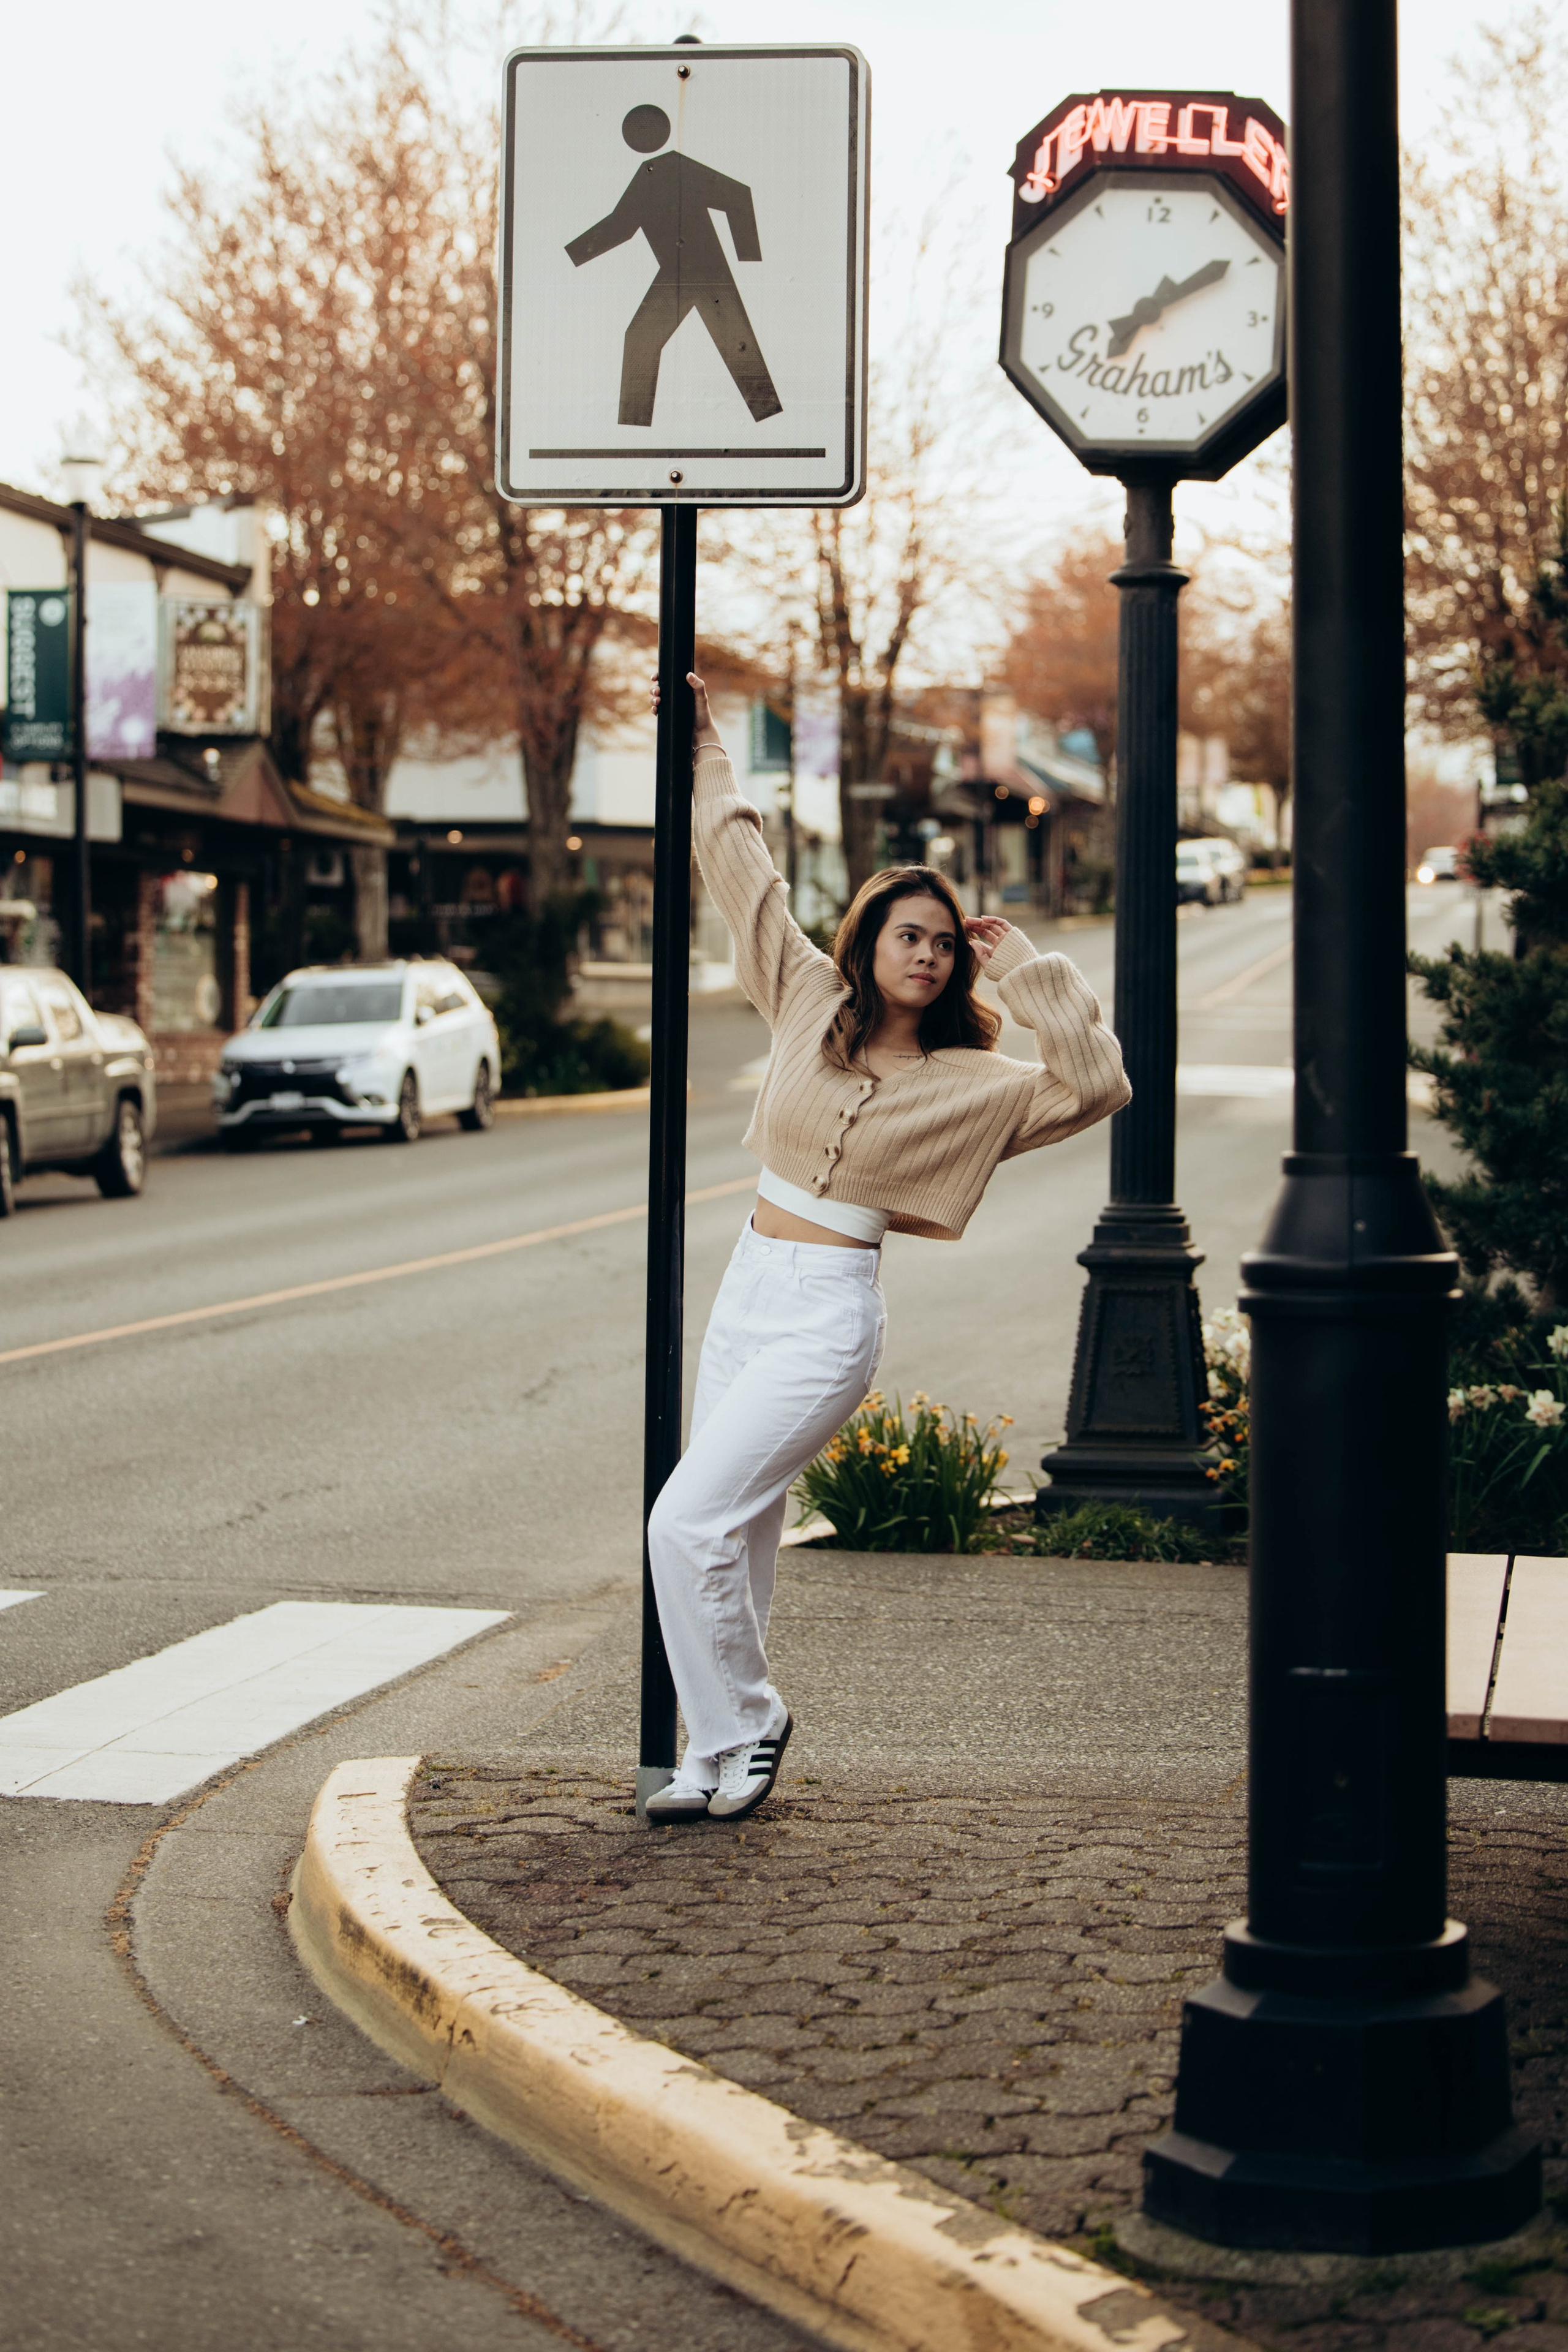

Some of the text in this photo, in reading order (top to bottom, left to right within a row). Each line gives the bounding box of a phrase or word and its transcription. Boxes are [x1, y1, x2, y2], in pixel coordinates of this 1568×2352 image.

[1147, 206, 1172, 223] 12
[1042, 303, 1054, 319] 9
[1246, 312, 1258, 328] 3
[1057, 324, 1233, 398] Graham's
[1136, 407, 1148, 423] 6
